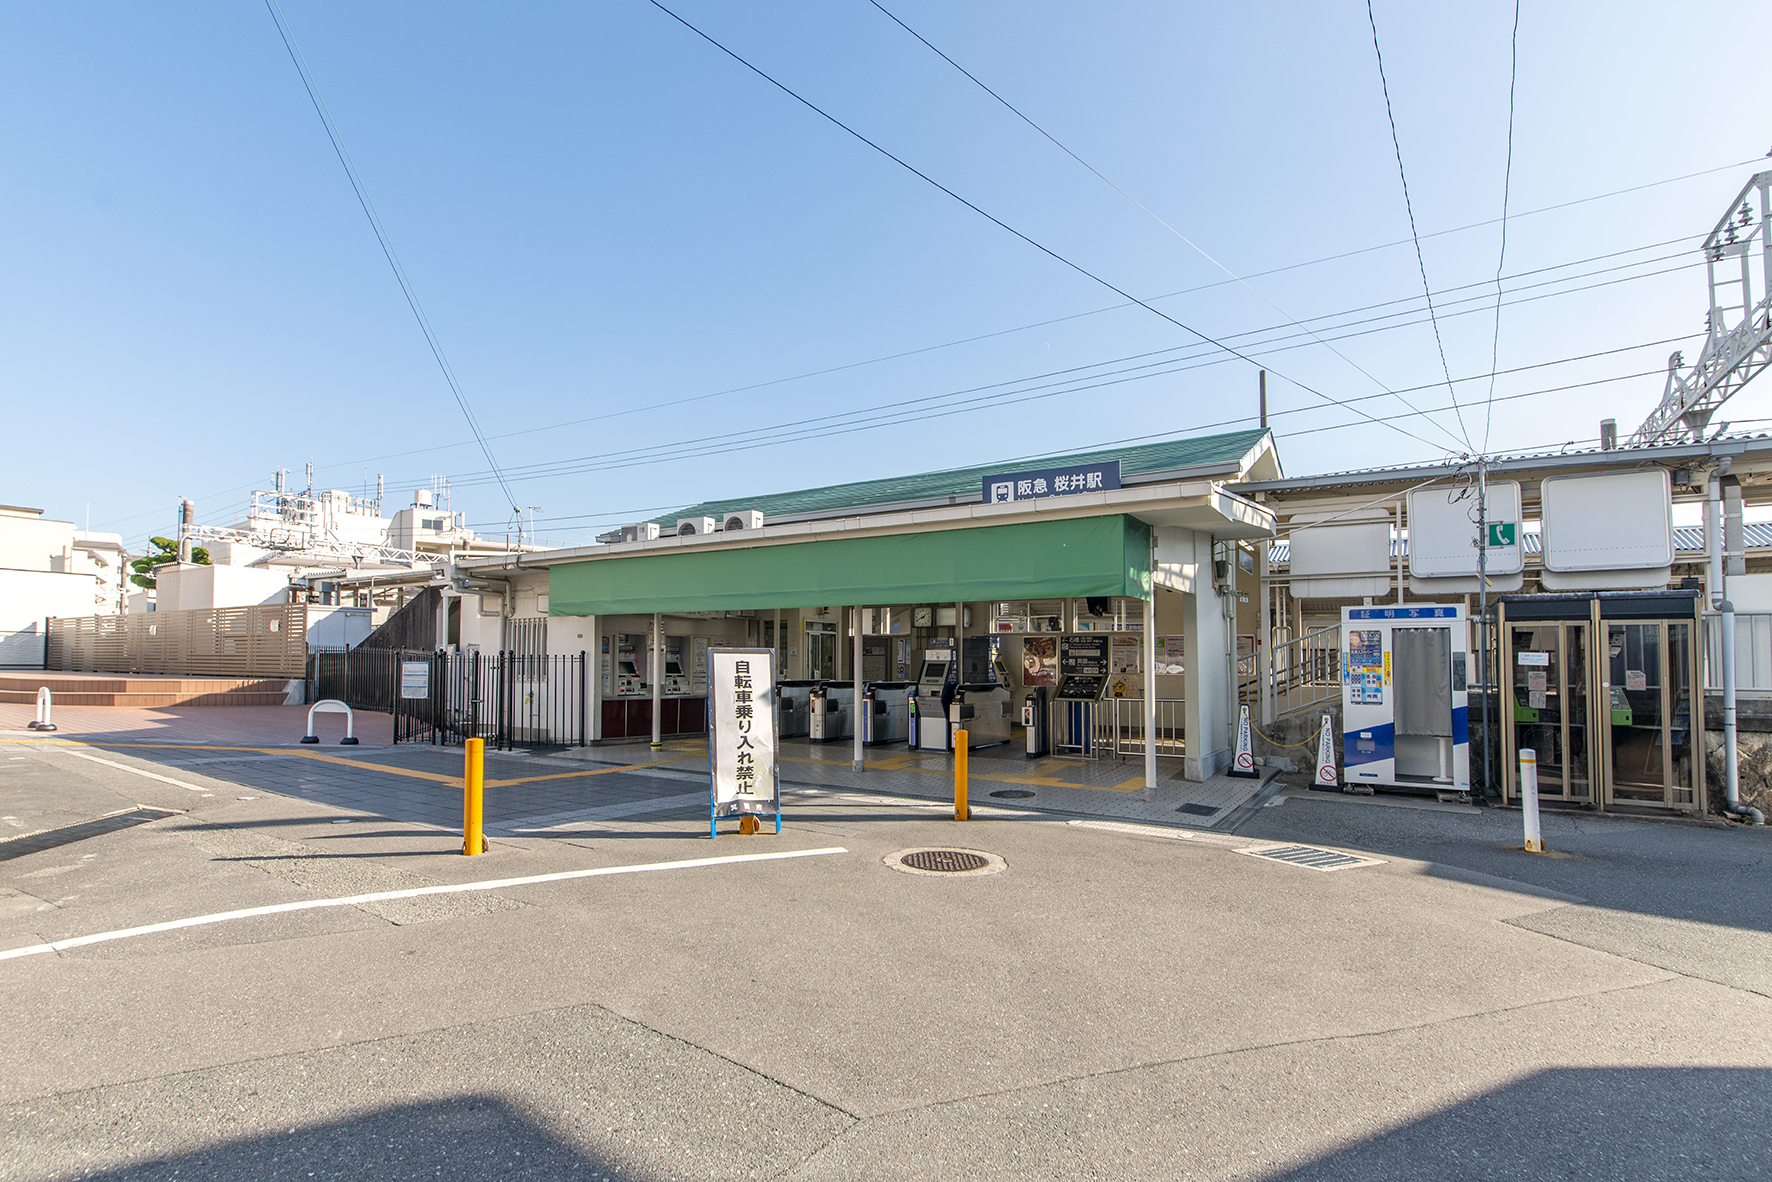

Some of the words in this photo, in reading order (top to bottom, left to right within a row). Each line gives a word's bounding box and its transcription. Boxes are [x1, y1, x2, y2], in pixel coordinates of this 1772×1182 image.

[1018, 479, 1048, 496] 阪急
[1055, 472, 1102, 491] 桜井駅
[1360, 608, 1445, 618] 証明写真
[734, 660, 754, 795] 自転車乗り入れ禁止
[1325, 728, 1331, 736] NO
